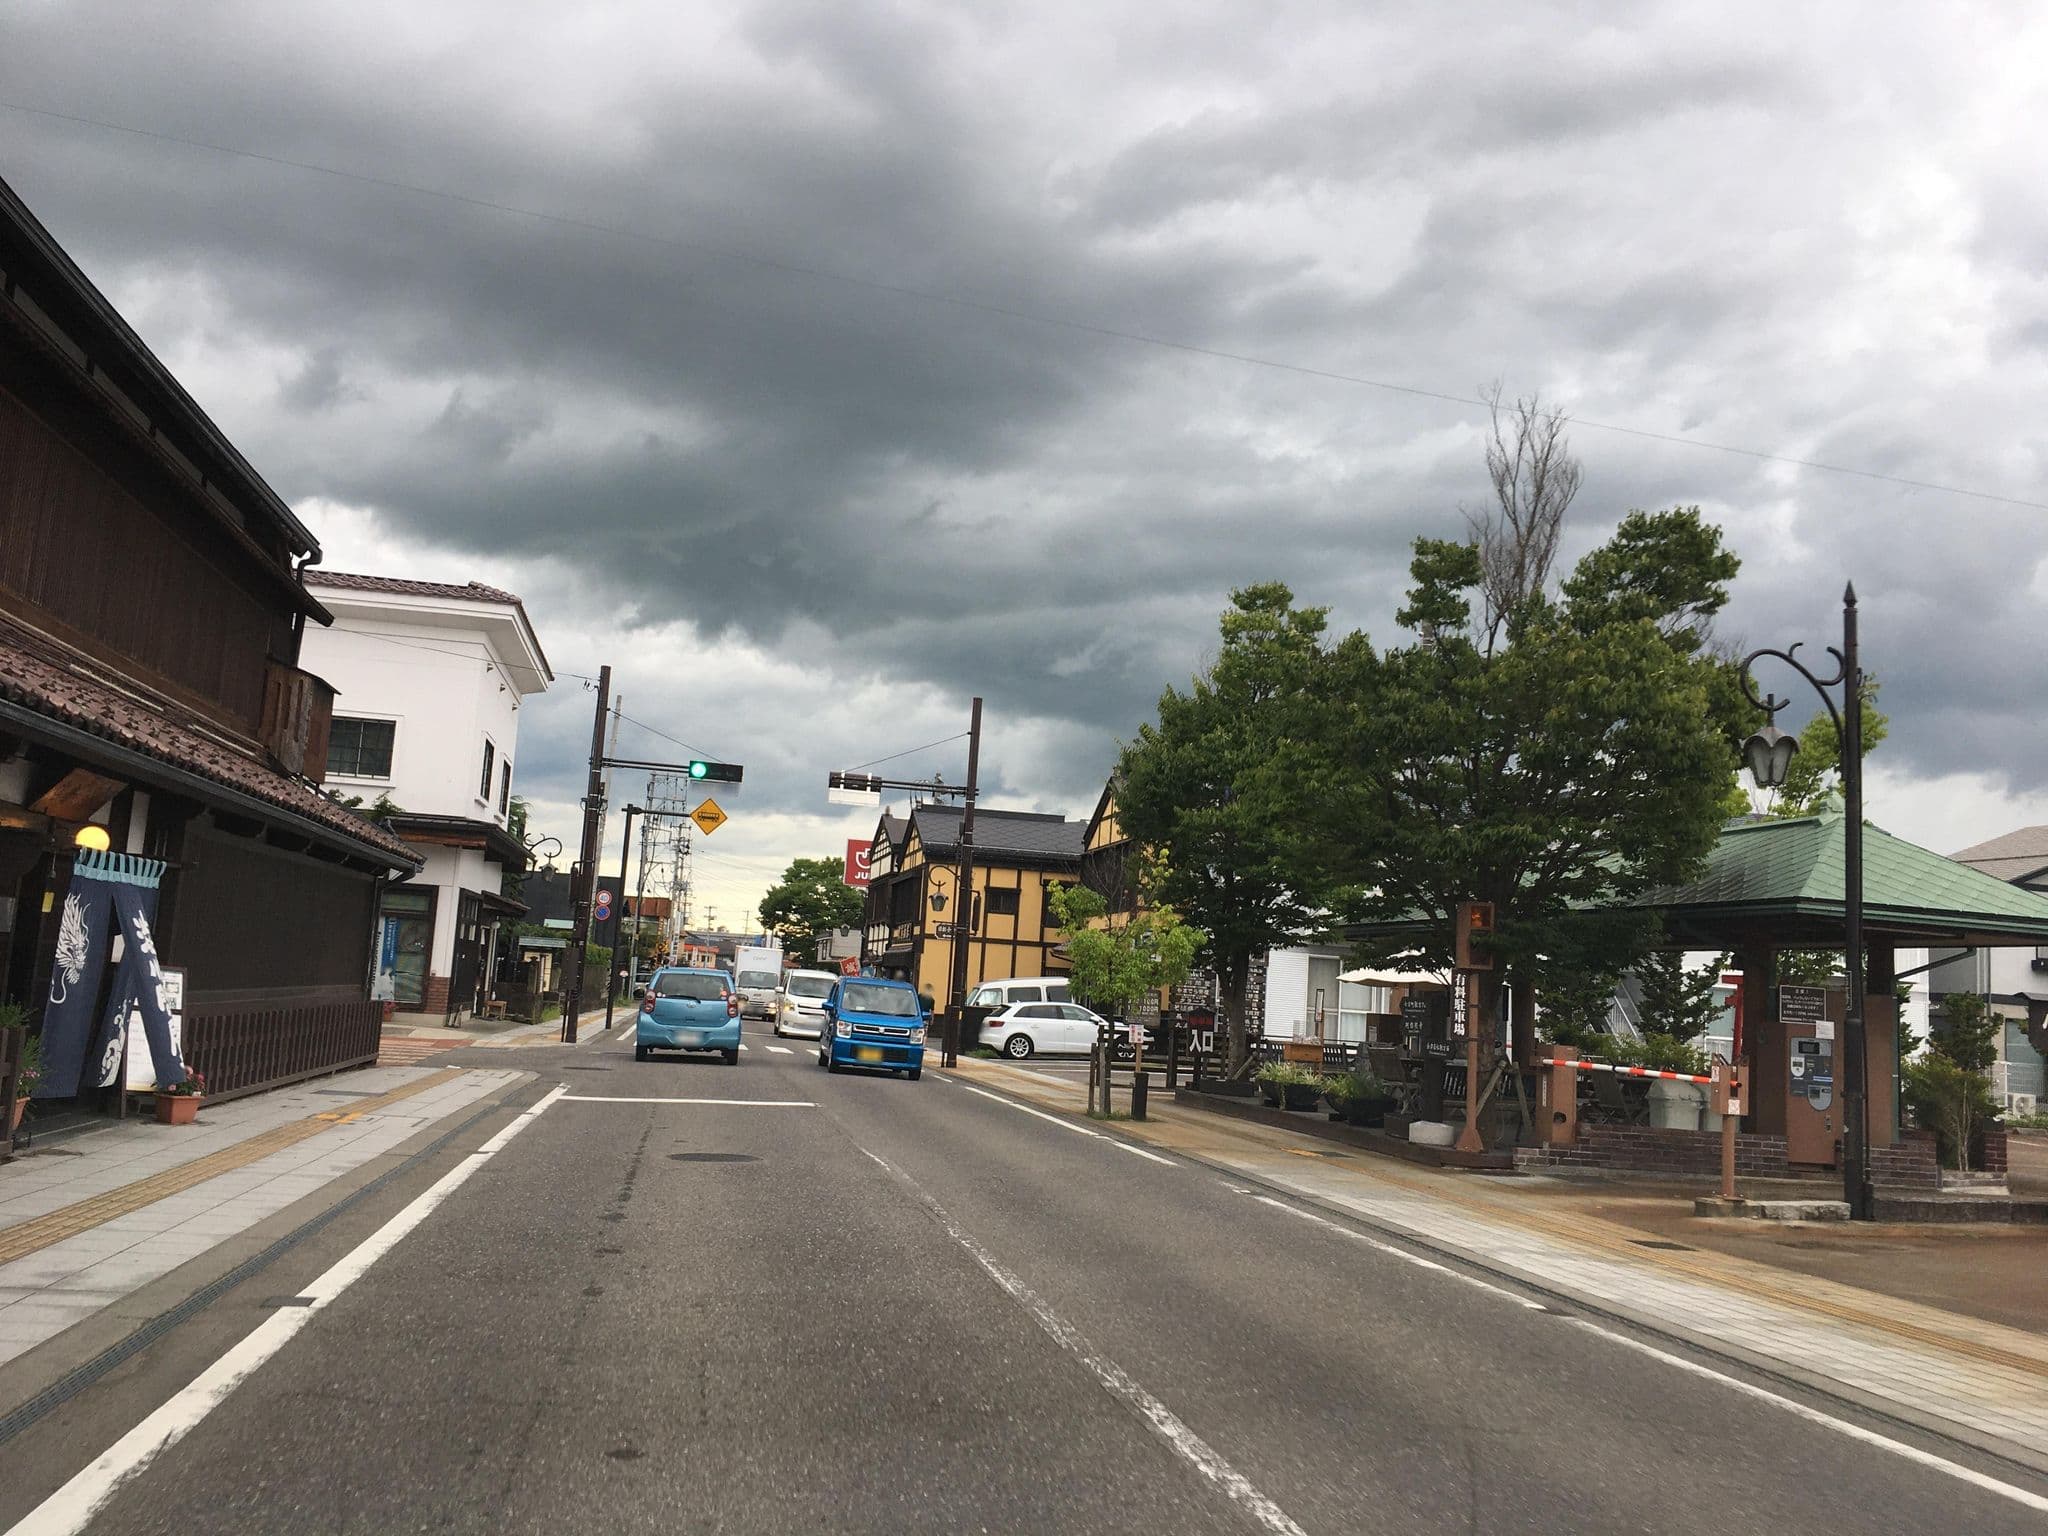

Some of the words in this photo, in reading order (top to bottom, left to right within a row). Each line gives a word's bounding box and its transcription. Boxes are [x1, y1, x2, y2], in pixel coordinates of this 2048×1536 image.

[1454, 974, 1466, 1035] 有料駐車場
[1189, 1029, 1214, 1053] 入口
